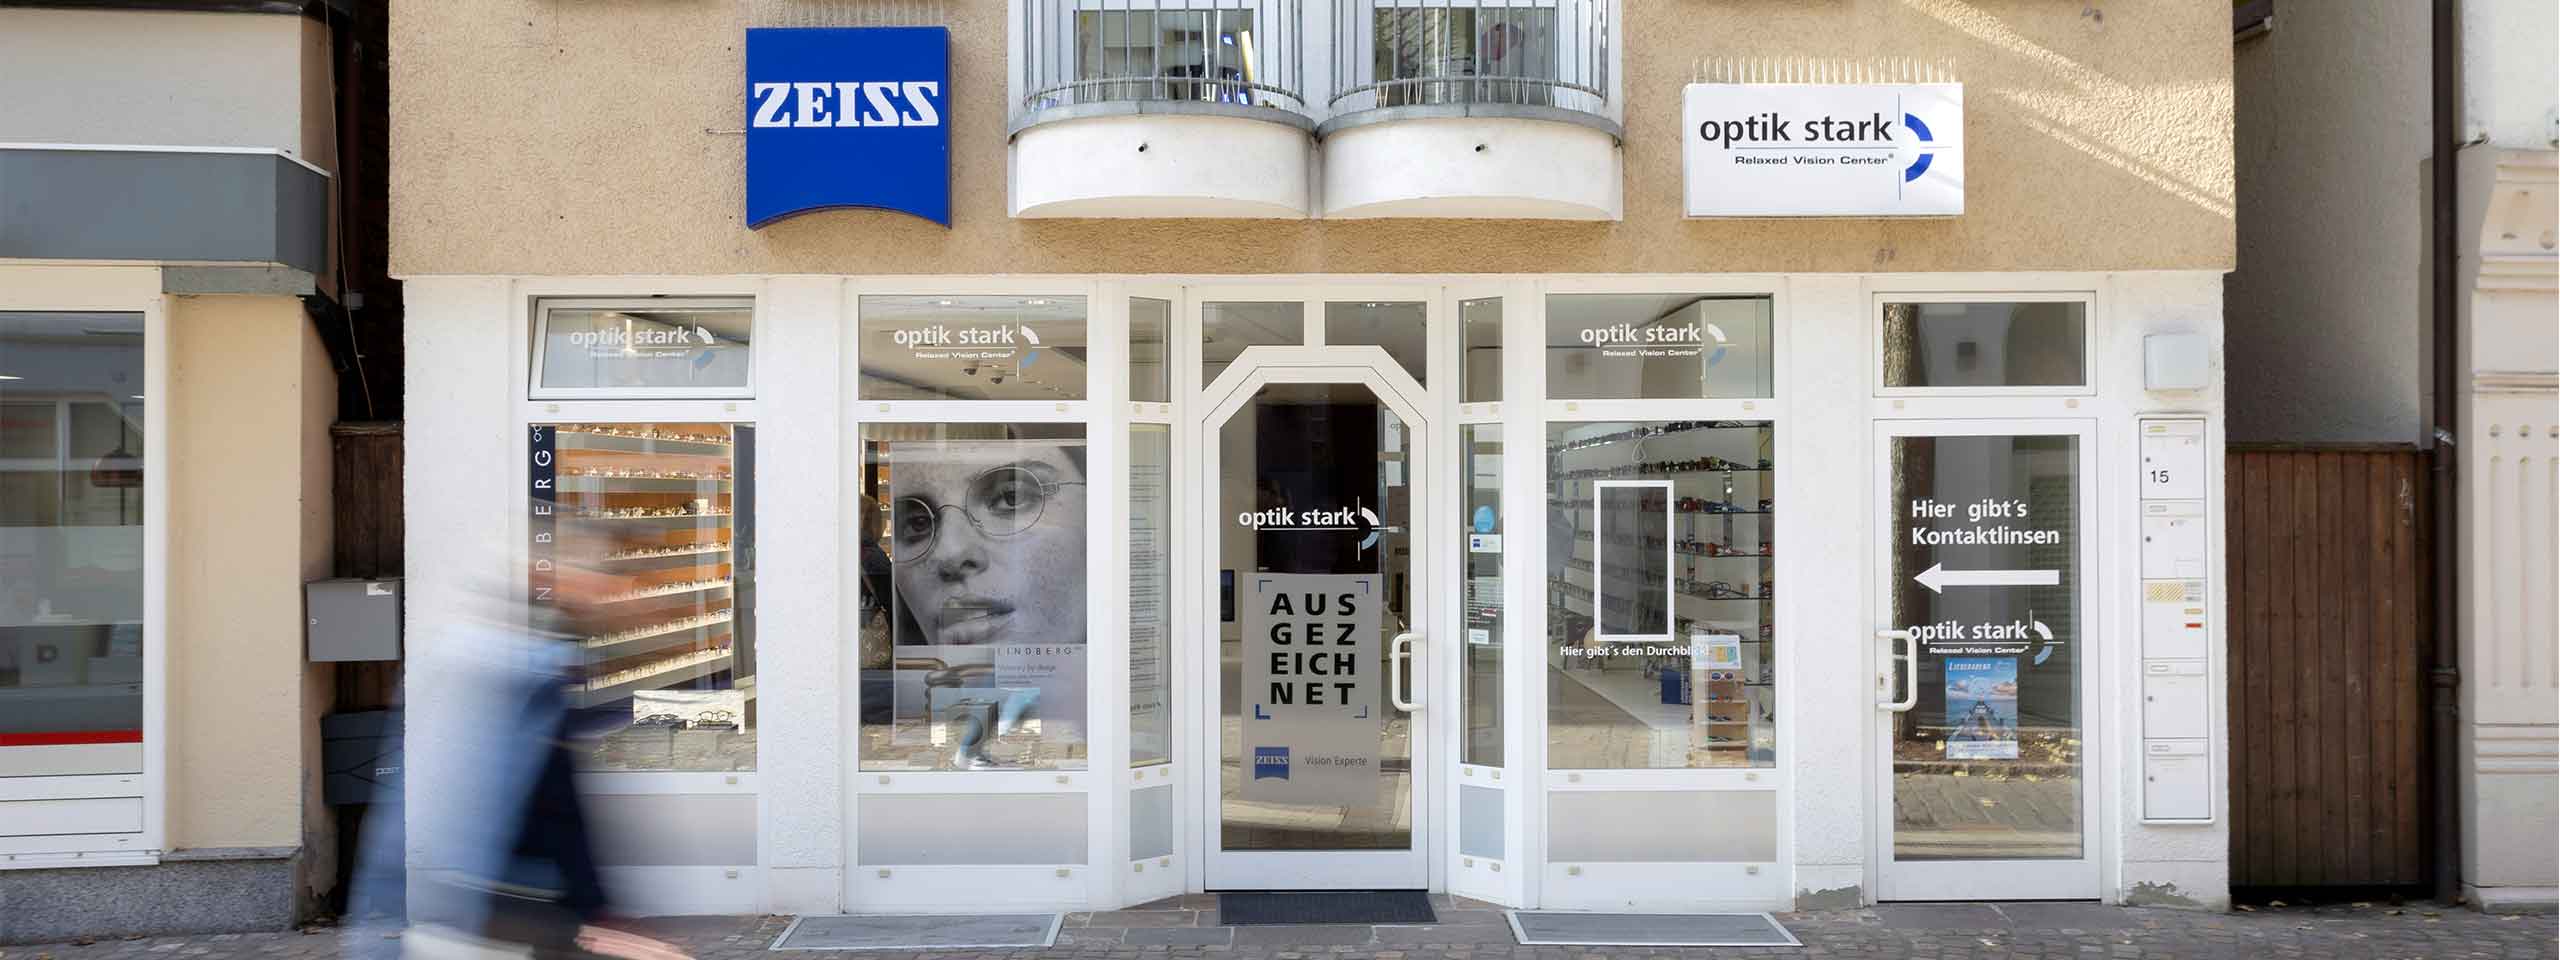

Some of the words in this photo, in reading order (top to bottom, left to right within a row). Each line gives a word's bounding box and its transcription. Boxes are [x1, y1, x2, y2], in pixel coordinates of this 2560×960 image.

[752, 81, 939, 128] ZEISS
[1699, 112, 1791, 150] optik
[1804, 112, 1893, 142] stark
[1735, 155, 1788, 165] Relaxed
[1793, 155, 1835, 165] Vision
[570, 326, 626, 349] optik
[635, 326, 690, 345] stark
[894, 325, 952, 349] optik
[959, 325, 1015, 344] stark
[1580, 323, 1638, 348] optik
[1645, 322, 1701, 343] stark
[2151, 470, 2169, 484] 15
[1238, 507, 1295, 531] optik
[1301, 506, 1356, 526] stark
[1912, 499, 1956, 518] Hier
[1912, 526, 2060, 545] Kontaktlinsen
[1270, 592, 1356, 616] AUS
[1270, 622, 1356, 646] GEZ
[1908, 620, 1965, 645] optik
[1972, 620, 2029, 640] stark
[1560, 645, 1585, 656] Hier
[1622, 645, 1644, 656] den
[1270, 652, 1356, 676] EICH
[1270, 682, 1356, 705] NET
[1255, 755, 1290, 766] ZEISS
[1304, 755, 1332, 767] Vision
[1334, 755, 1368, 768] Experte
